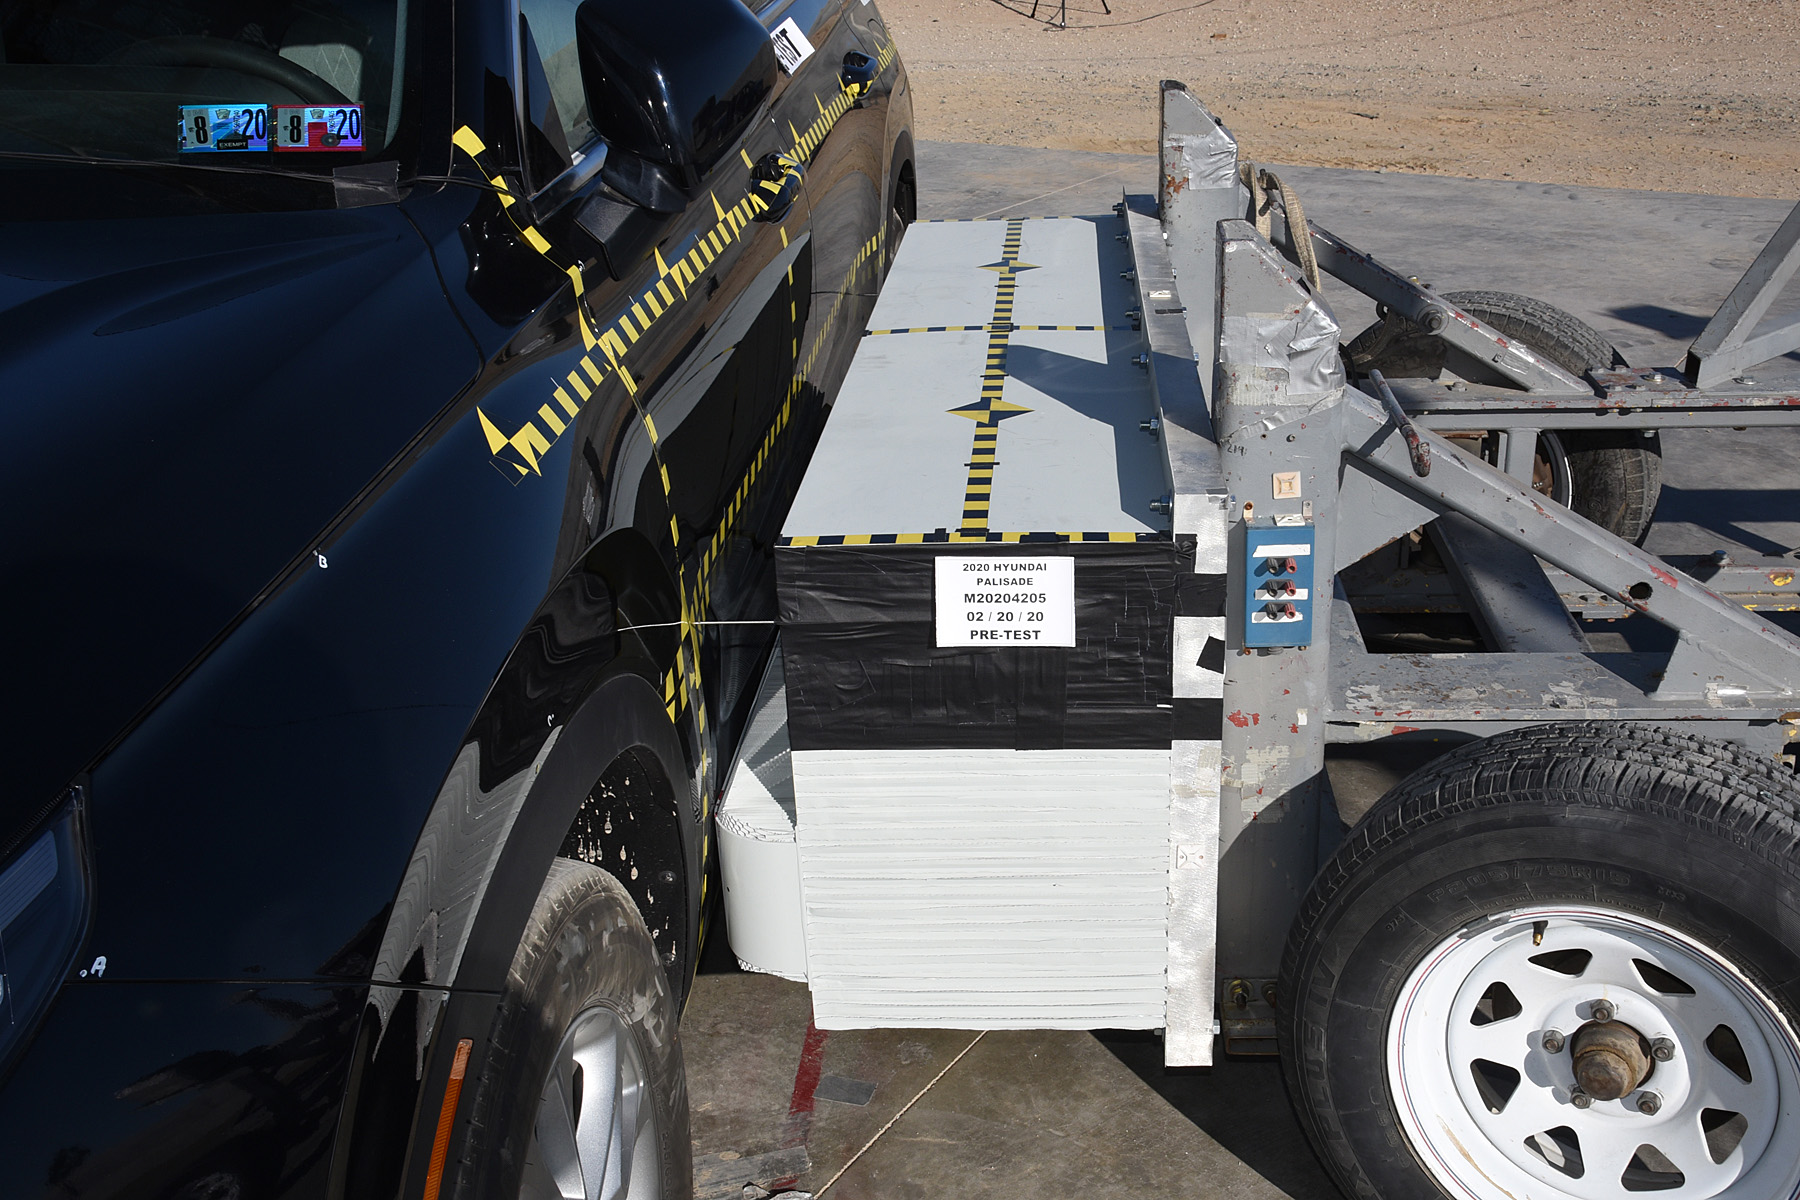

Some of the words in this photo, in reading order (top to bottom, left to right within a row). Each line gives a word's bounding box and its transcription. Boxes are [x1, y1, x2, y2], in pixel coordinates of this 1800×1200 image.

[193, 116, 209, 144] 8
[242, 108, 267, 139] 20
[289, 115, 302, 143] 8
[336, 108, 360, 139] 20
[962, 563, 990, 572] 2020
[993, 563, 1047, 572] HYUNDAI
[976, 577, 1034, 586] PALISADE
[964, 593, 1046, 604] M20204205
[966, 612, 984, 622] 02
[997, 612, 1014, 622] 20
[1027, 612, 1044, 622] 20
[970, 630, 1041, 640] PRE-TEST
[90, 955, 107, 978] A
